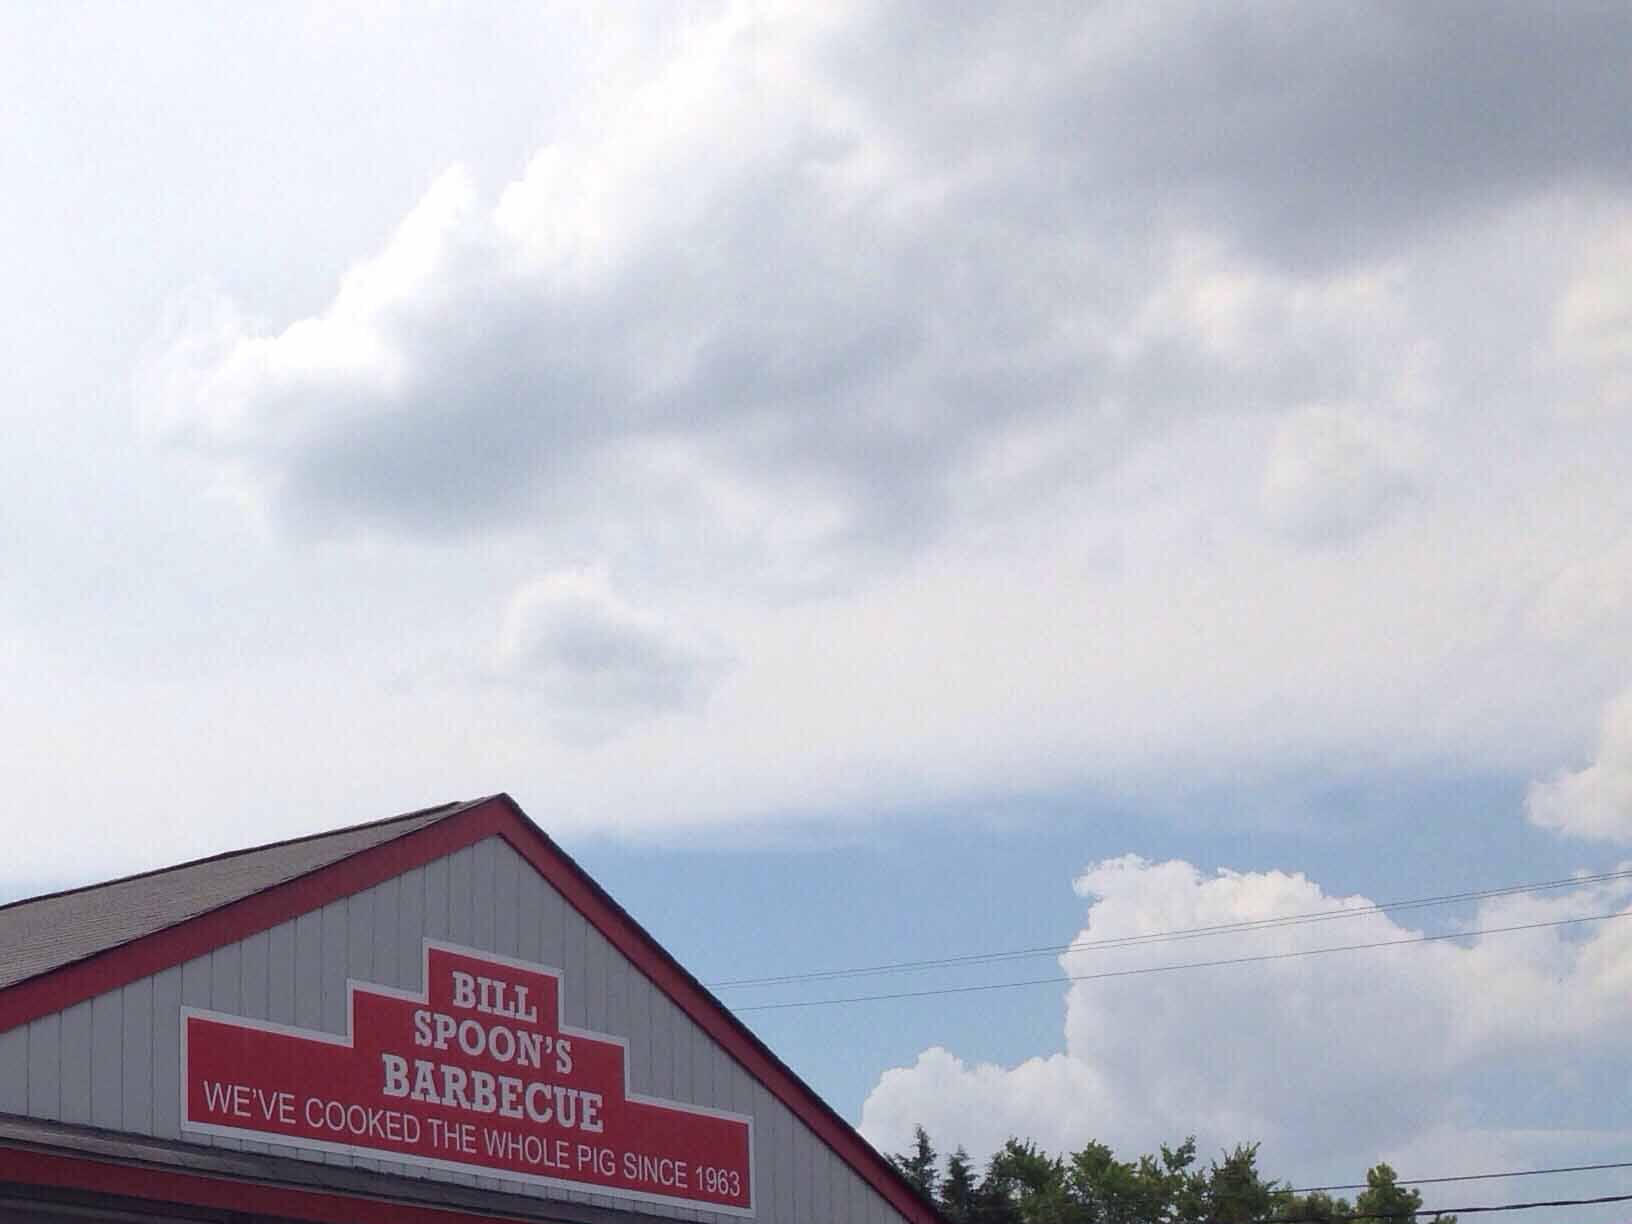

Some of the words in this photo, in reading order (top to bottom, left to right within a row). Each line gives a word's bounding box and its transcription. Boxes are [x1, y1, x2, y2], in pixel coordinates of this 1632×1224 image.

[451, 970, 537, 1023] BILL
[413, 1009, 573, 1074] SPOON'S
[381, 1052, 604, 1134] BARBECUE
[203, 1080, 297, 1124] WE'VE
[304, 1097, 421, 1144] COOKED
[426, 1117, 477, 1153] THE
[483, 1128, 570, 1170] WHOLE
[577, 1140, 617, 1176] PIG
[623, 1151, 688, 1189] SINCE
[695, 1165, 741, 1197] 1963
